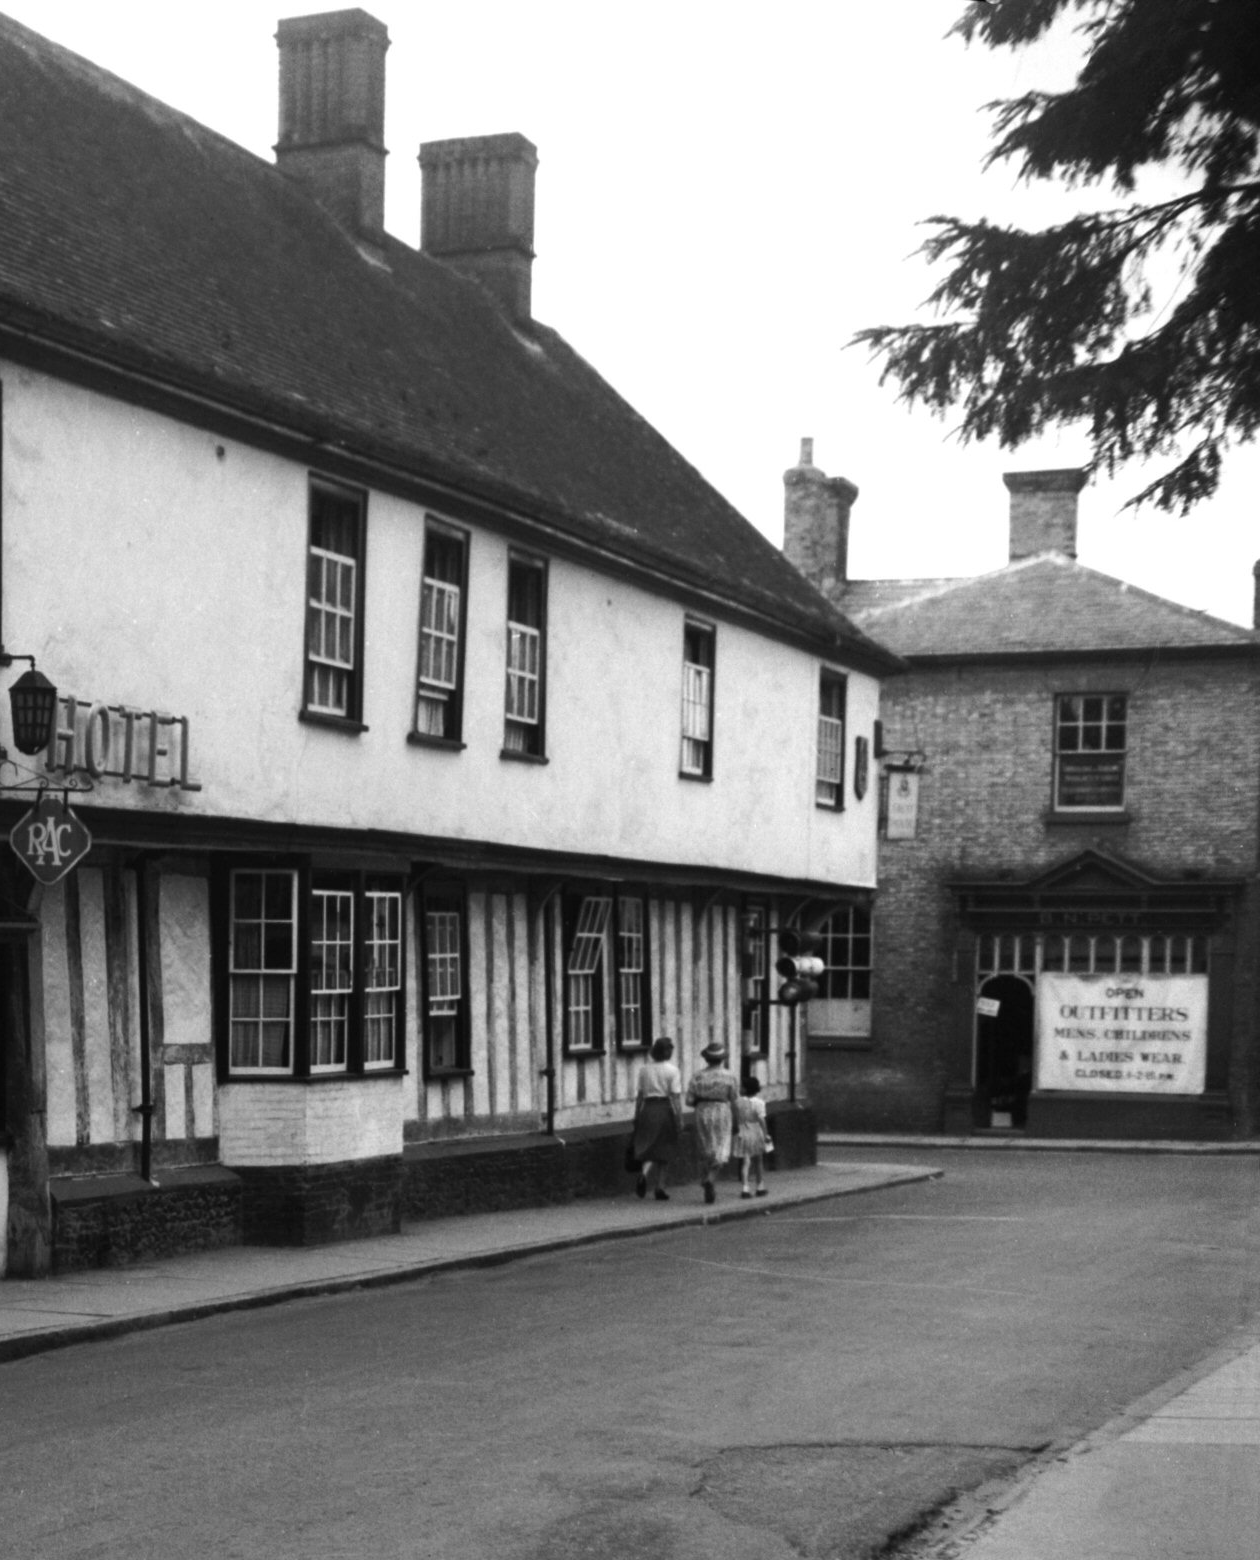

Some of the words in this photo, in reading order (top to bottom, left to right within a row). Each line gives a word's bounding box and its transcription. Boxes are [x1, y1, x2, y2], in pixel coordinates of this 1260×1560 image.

[46, 694, 202, 791] HOTEL
[26, 816, 73, 867] RAC
[1105, 987, 1144, 1000] OPEN
[1059, 1004, 1189, 1022] OUTFITTERS
[1104, 1029, 1191, 1042] CHILDRENS
[1059, 1049, 1070, 1061] &
[1077, 1050, 1134, 1063] LADIES
